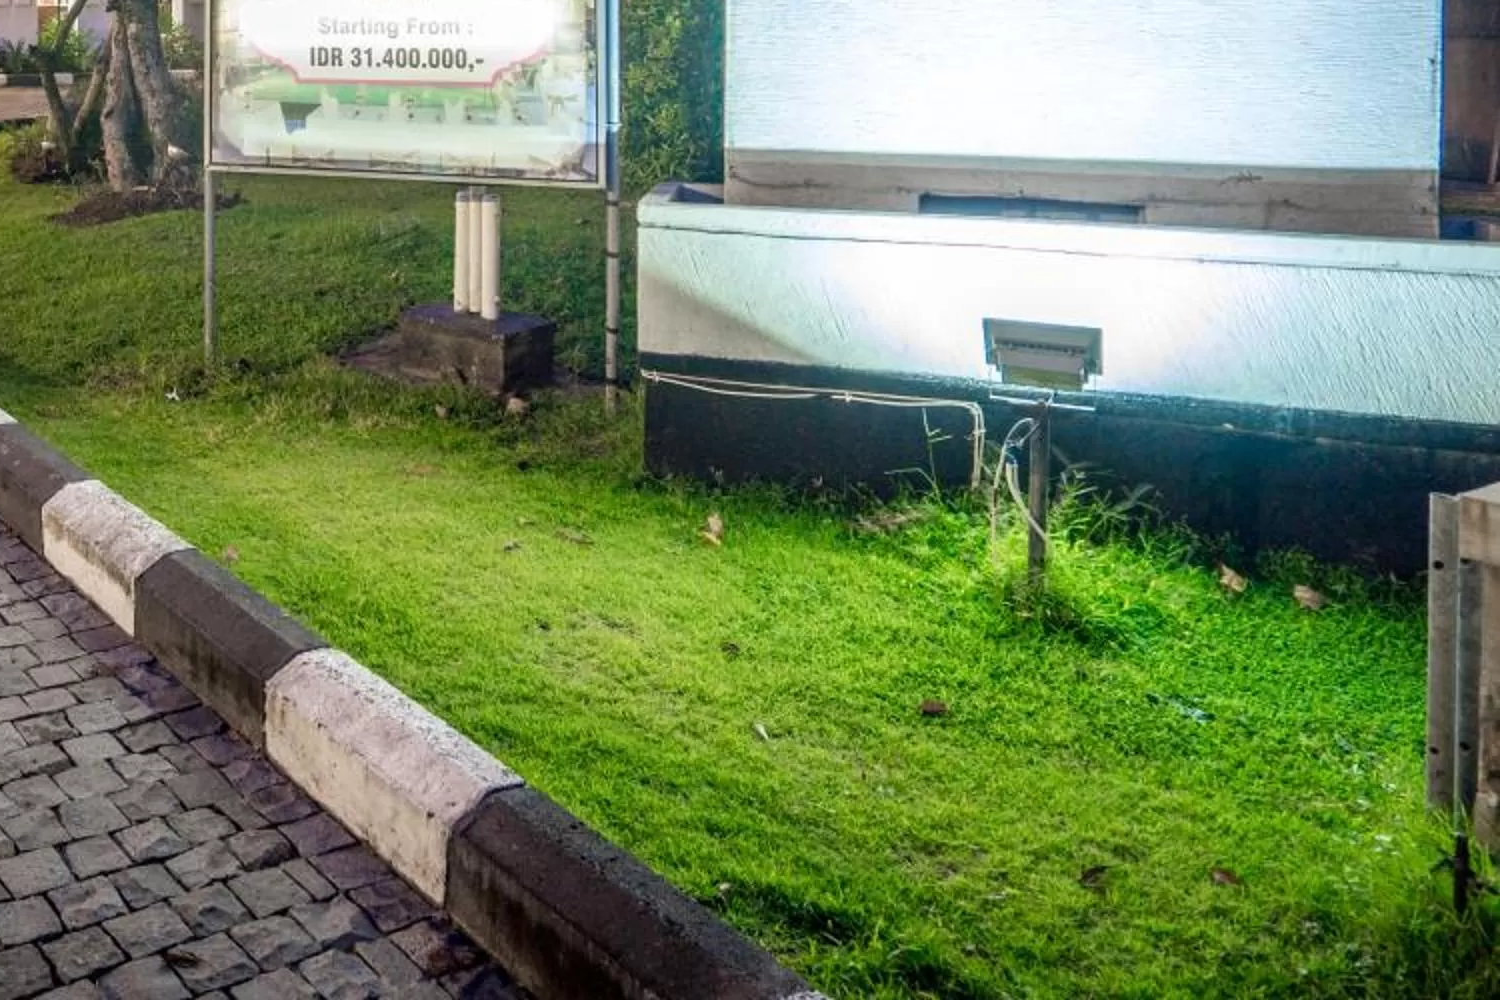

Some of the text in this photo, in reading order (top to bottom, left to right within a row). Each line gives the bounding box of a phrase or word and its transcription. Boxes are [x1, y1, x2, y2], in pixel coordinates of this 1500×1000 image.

[318, 17, 400, 39] Starting
[407, 18, 460, 35] From
[310, 46, 484, 73] IDR 31.400.000,-
